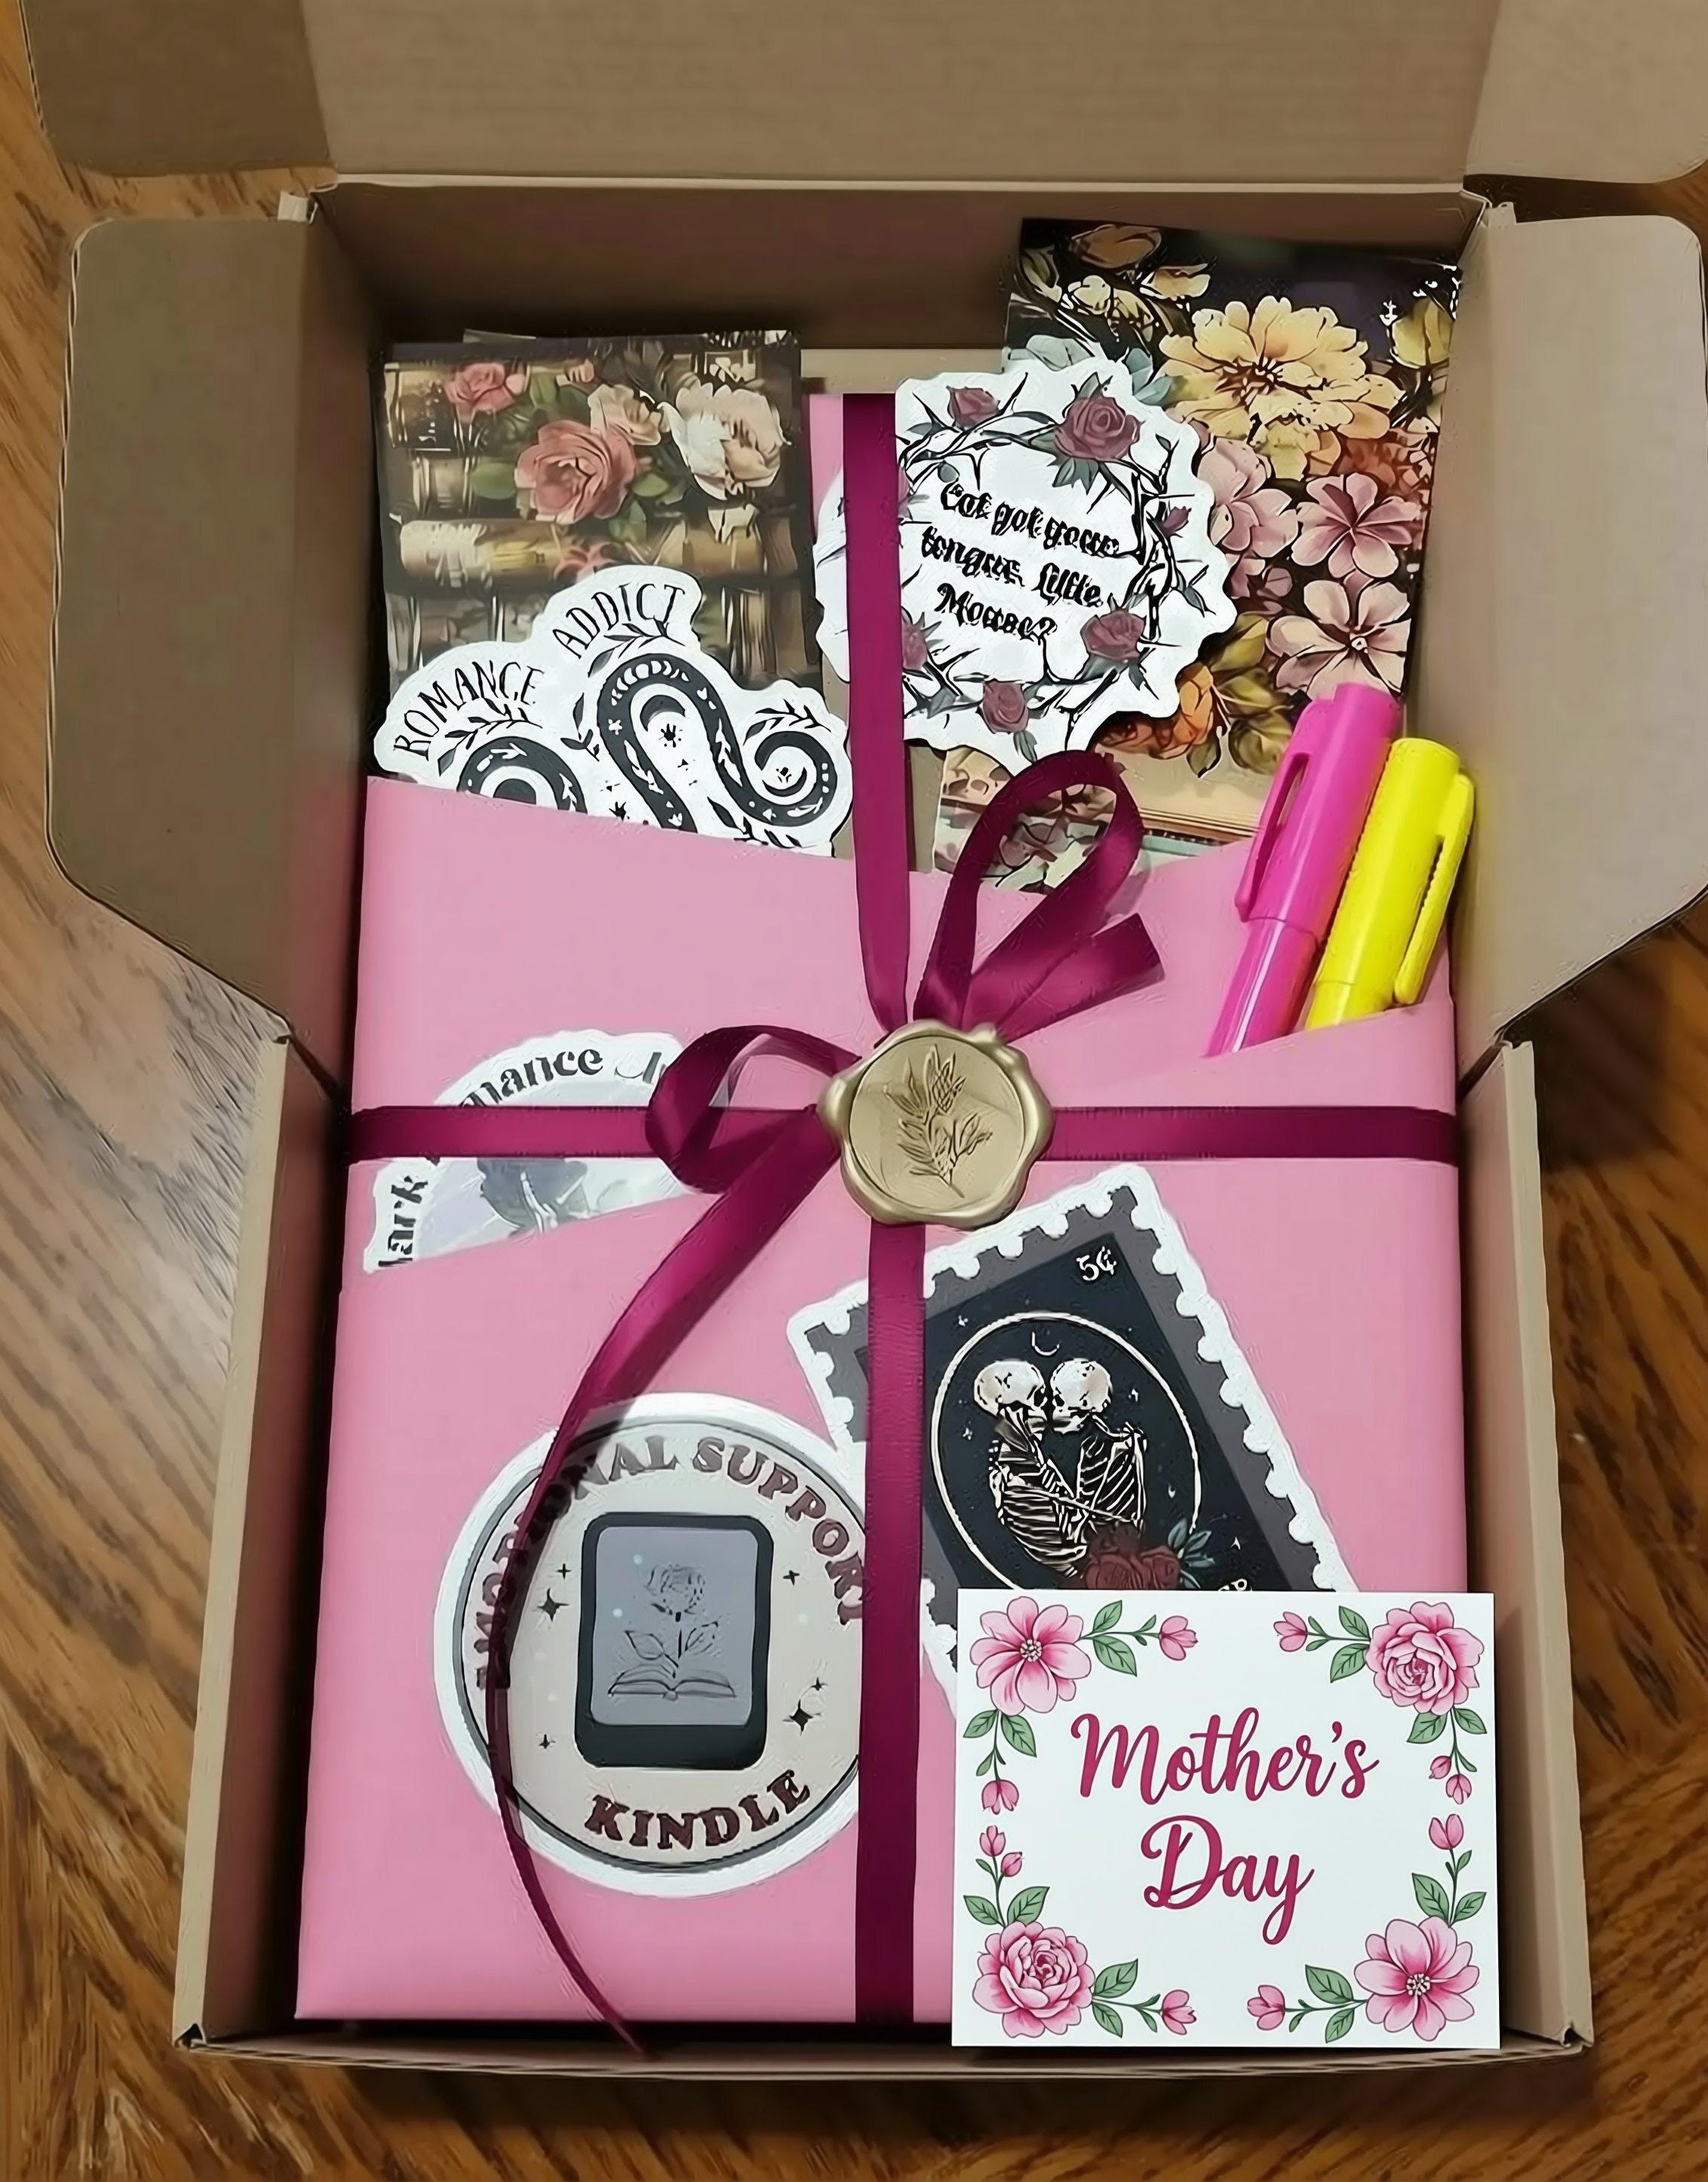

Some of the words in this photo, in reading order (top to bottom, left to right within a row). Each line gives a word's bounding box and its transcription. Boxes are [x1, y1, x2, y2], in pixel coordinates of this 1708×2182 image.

[991, 501, 1044, 539] got
[393, 660, 544, 761] ROMANCE
[552, 583, 686, 659] ADDICT
[378, 1176, 429, 1268] ark
[1071, 1707, 1380, 1806] Mother's
[584, 1769, 811, 1850] KINDLE
[1140, 1815, 1315, 1946] Day
